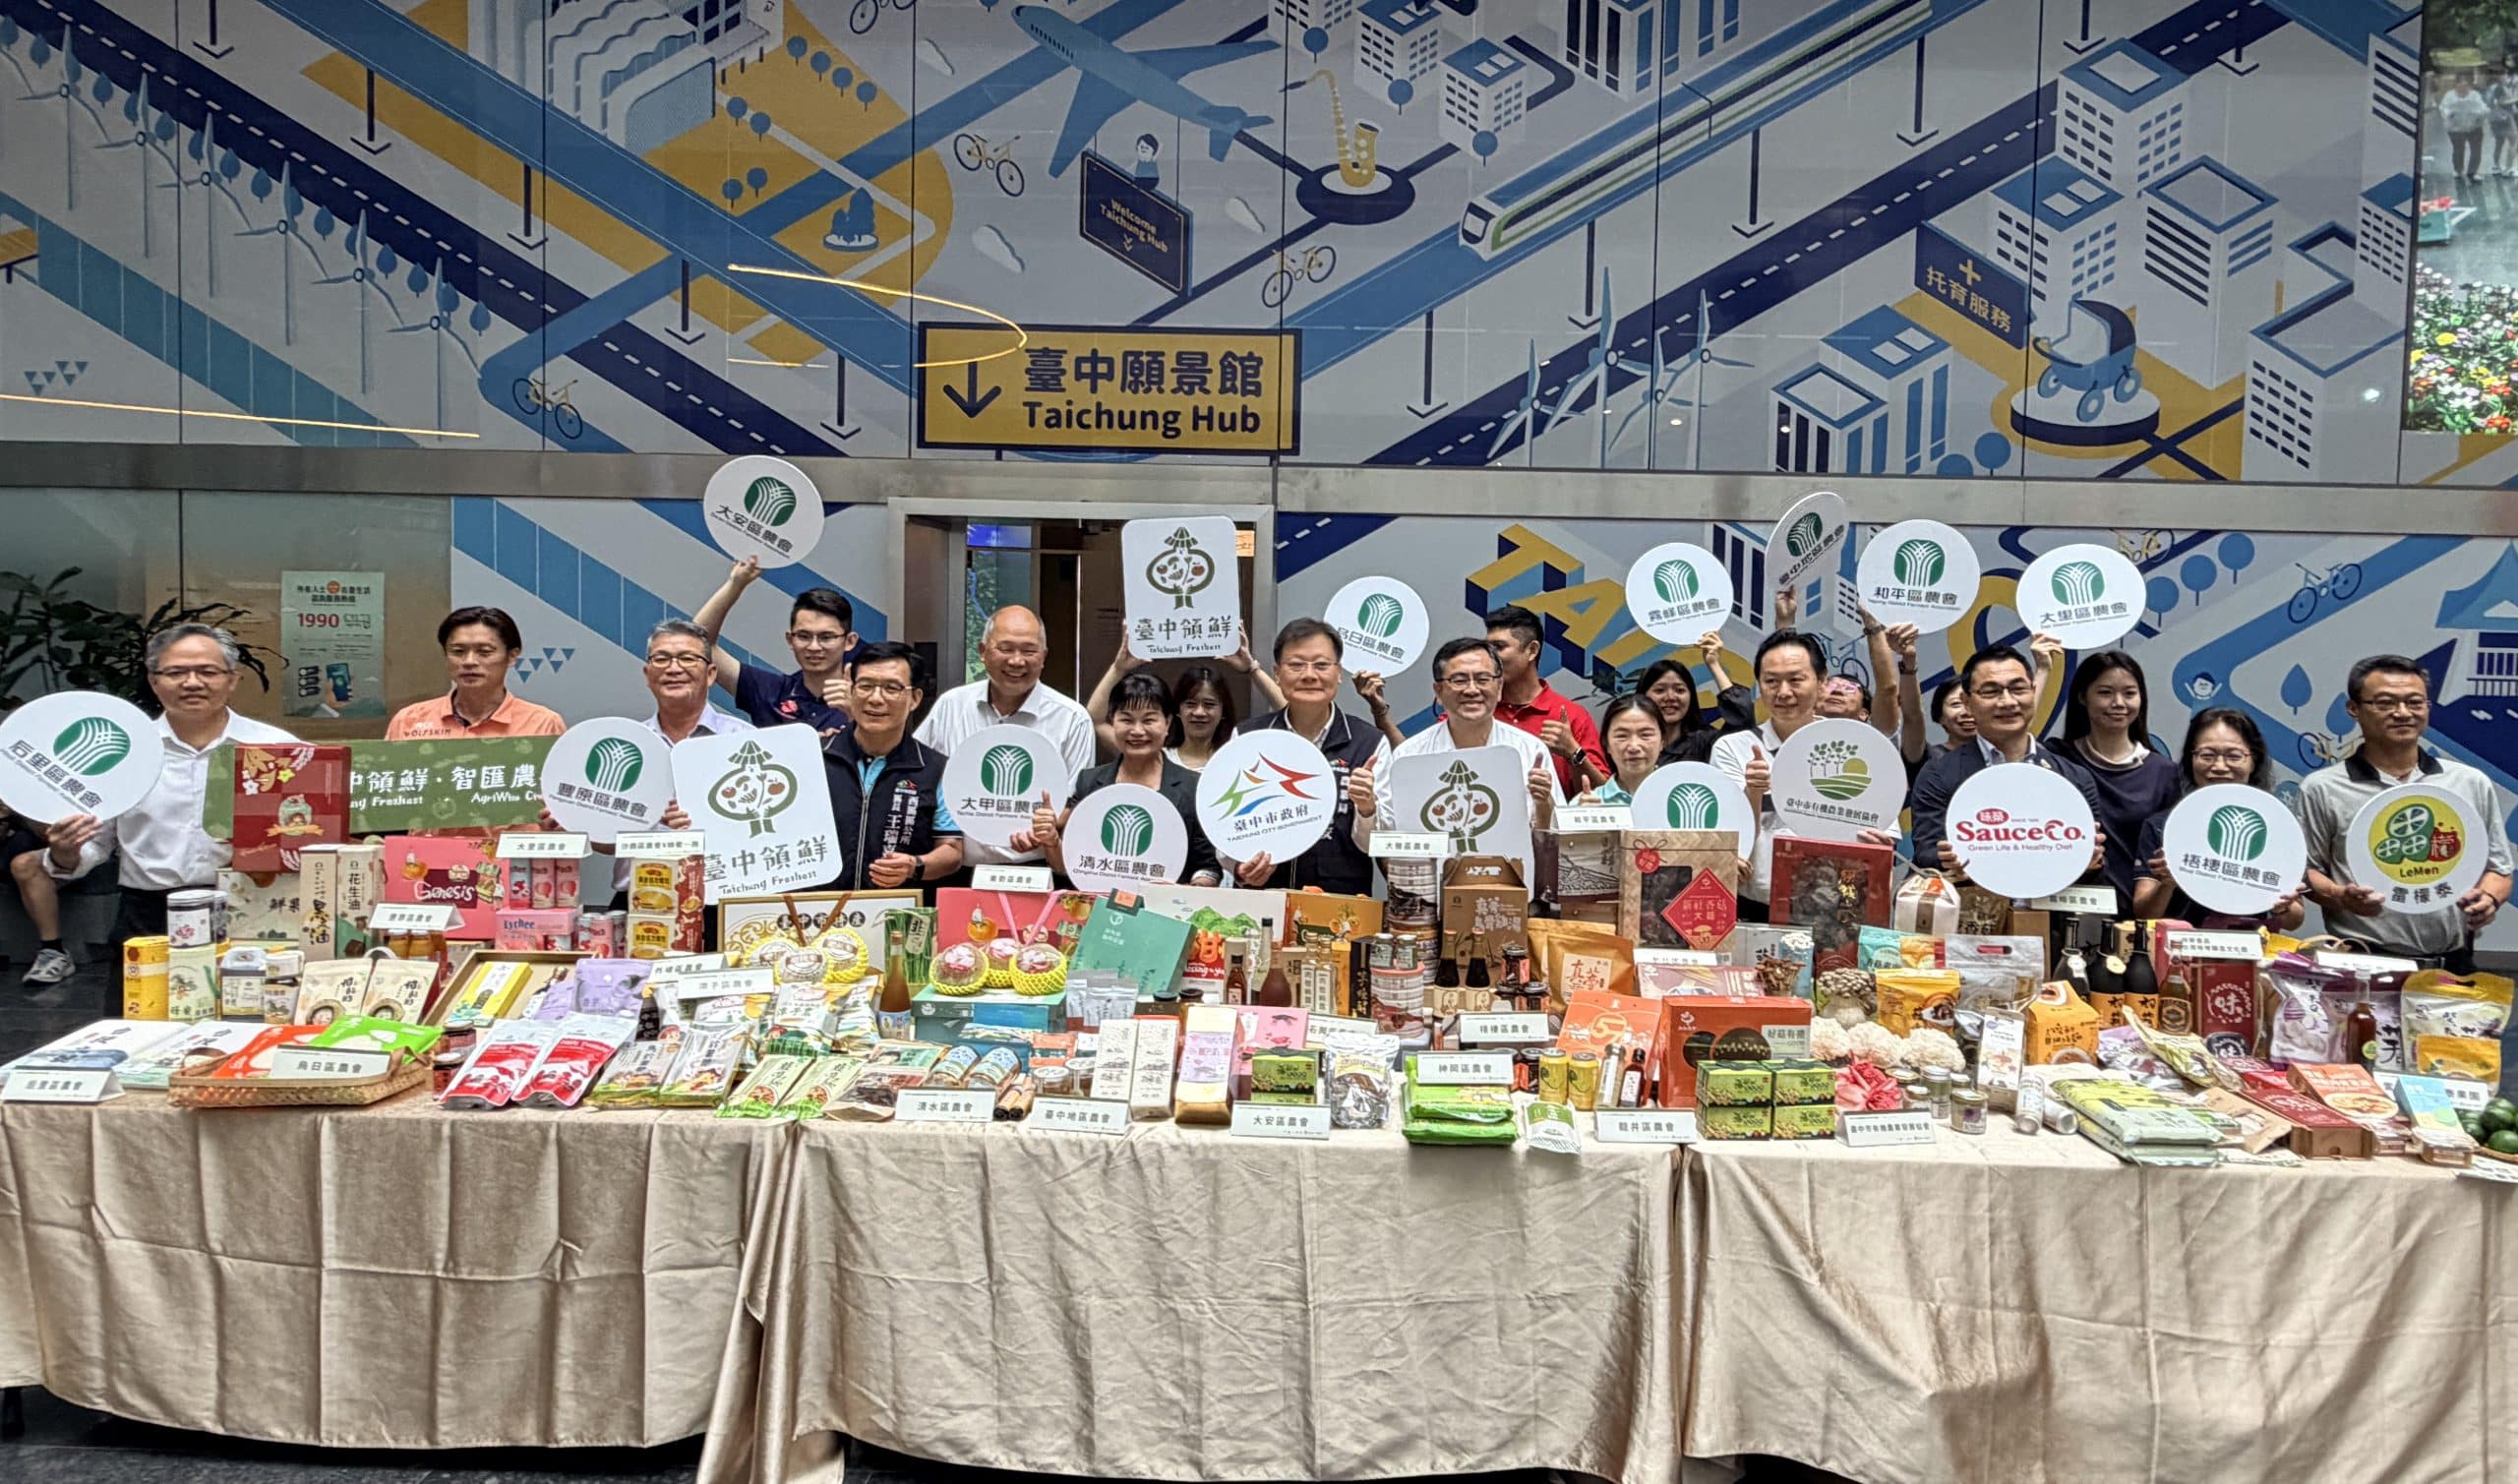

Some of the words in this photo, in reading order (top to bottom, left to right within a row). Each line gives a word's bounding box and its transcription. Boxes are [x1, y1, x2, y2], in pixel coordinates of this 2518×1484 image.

[1101, 204, 1148, 243] Taichung
[1147, 235, 1169, 254] Hub
[1110, 199, 1158, 235] Welcome
[1926, 266, 2012, 333] 托育服務
[1024, 347, 1264, 398] 臺中願景館
[1023, 401, 1182, 440] Taichung
[1192, 405, 1261, 434] Hub
[715, 505, 794, 553] 大安區農會
[1873, 586, 1958, 605] 和平區農會
[2040, 602, 2127, 623] 大里區農會
[297, 613, 340, 627] 1990
[1134, 616, 1232, 640] 臺中領鮮
[8, 740, 102, 809] 后里區農會
[557, 782, 649, 818] 豐原區農會
[1234, 802, 1309, 833] 臺中市政府
[704, 835, 827, 883] 臺中領鮮
[1079, 855, 1166, 878] 清水區農會
[2183, 853, 2282, 887] 梧棲區農會
[2400, 866, 2440, 878] LeMon
[718, 880, 767, 896] Taichung
[1252, 1114, 1310, 1128] 大安區農會
